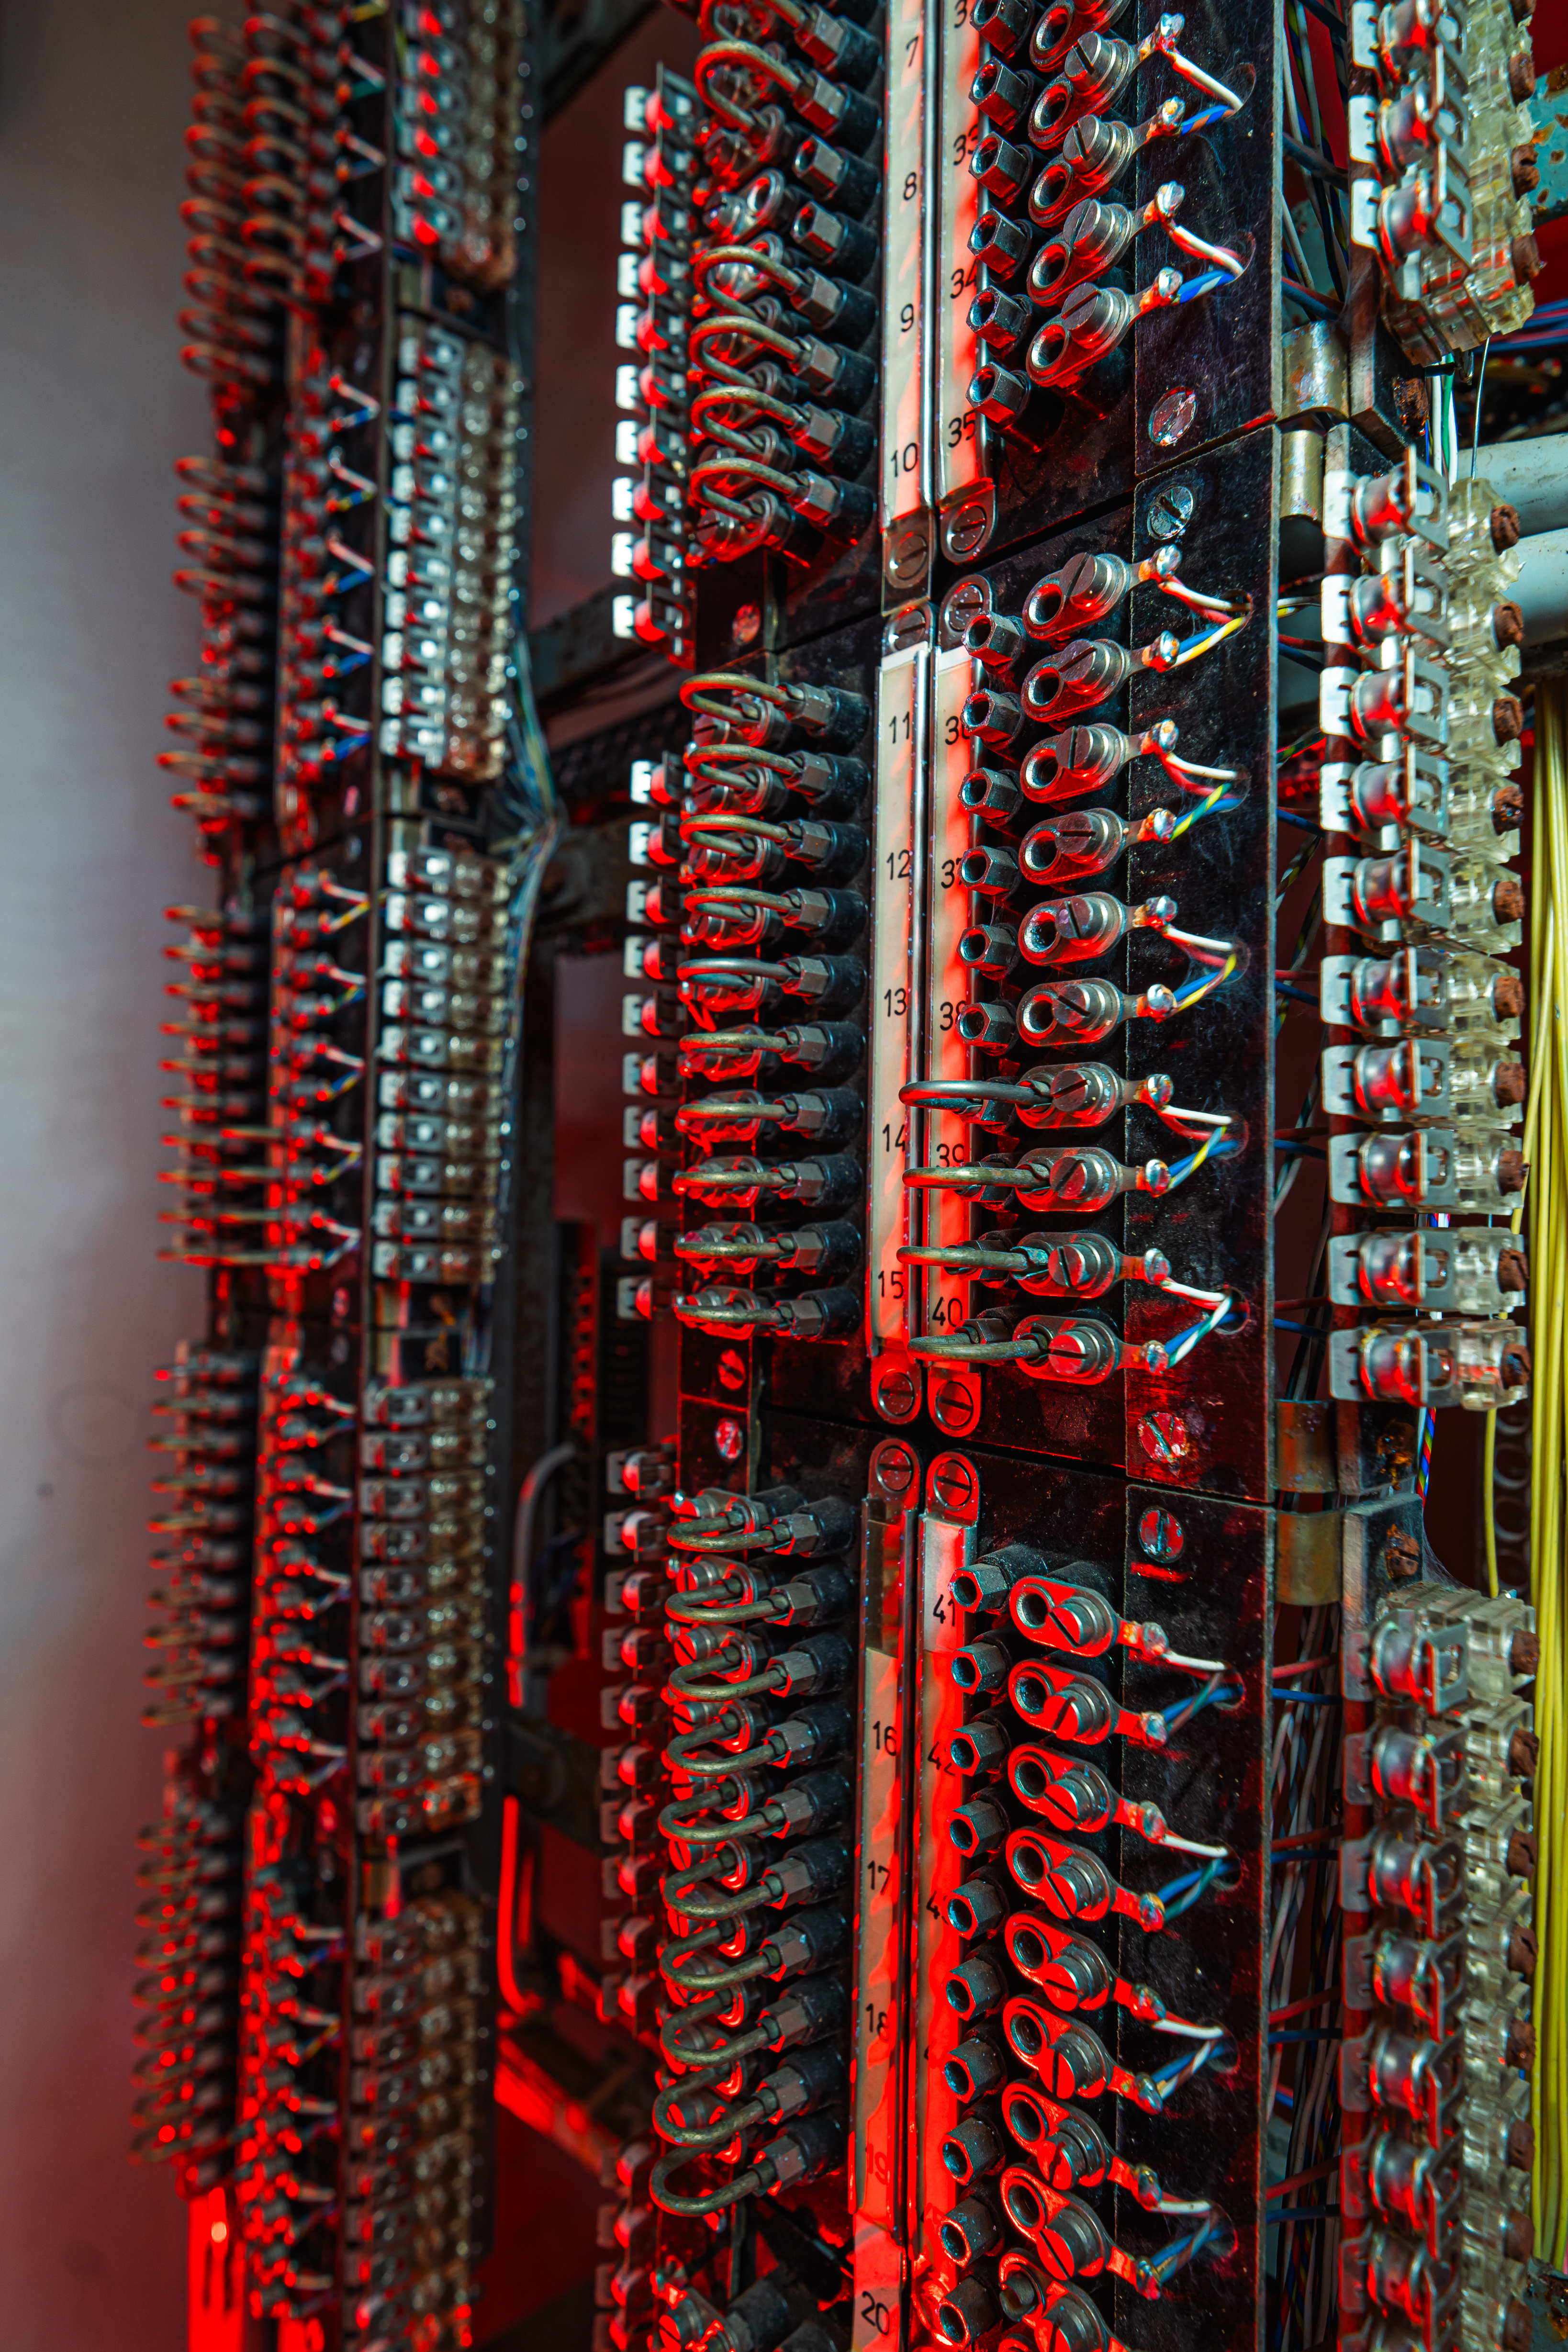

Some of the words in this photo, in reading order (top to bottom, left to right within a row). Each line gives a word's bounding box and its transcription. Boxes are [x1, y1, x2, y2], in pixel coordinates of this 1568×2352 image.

[906, 36, 919, 67] 7
[903, 172, 917, 201] 8
[900, 303, 914, 332] 9
[948, 409, 975, 448] 35
[891, 442, 918, 478] 10
[889, 712, 910, 744] 11
[886, 849, 910, 880] 12
[884, 988, 907, 1017] 13
[882, 1123, 906, 1152] 14
[878, 1270, 904, 1299] 15
[932, 1296, 963, 1328] 40
[932, 1594, 955, 1626] 41
[873, 1721, 897, 1756] 16
[867, 1860, 891, 1895] 17
[926, 1890, 950, 1926] 4
[866, 2003, 890, 2042] 18
[866, 2143, 889, 2186] 19
[861, 2291, 890, 2336] 20
